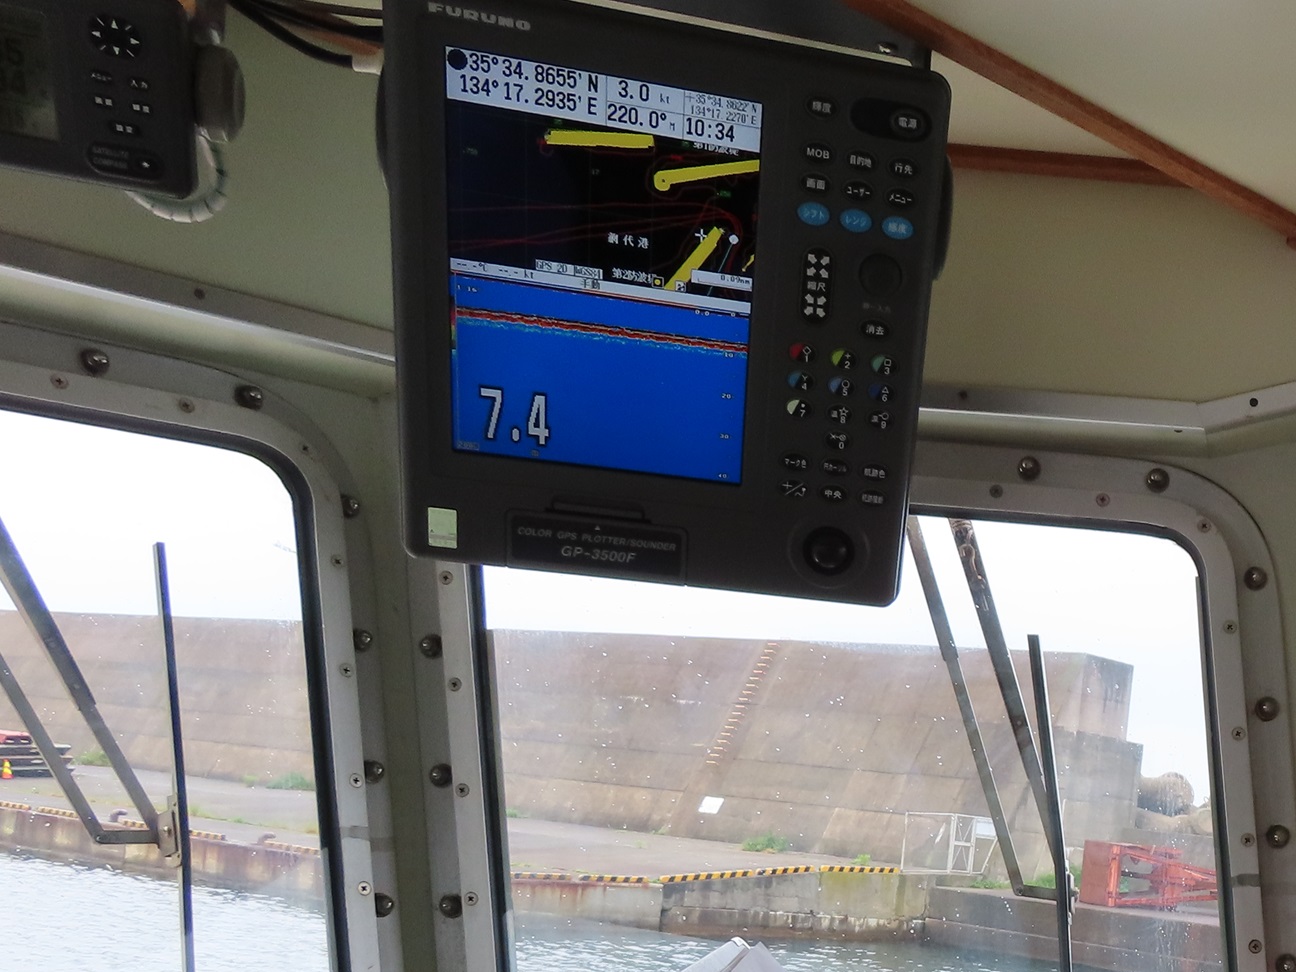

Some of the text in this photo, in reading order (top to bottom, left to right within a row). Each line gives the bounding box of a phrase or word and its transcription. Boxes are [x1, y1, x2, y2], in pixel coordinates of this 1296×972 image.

[427, 2, 531, 31] FURUNO
[588, 73, 598, 93] N
[618, 80, 670, 104] 3.0 kt
[588, 97, 598, 115] E
[898, 117, 917, 129] 電源
[686, 117, 735, 143] 10:34
[807, 147, 830, 159] MOB
[850, 155, 872, 168] 目的地
[895, 163, 913, 175] 行先
[806, 178, 826, 190] 画面
[847, 186, 870, 196] ユーザー
[889, 193, 912, 204] メニュー
[803, 209, 825, 220] シフト
[845, 215, 867, 227] レンジ
[536, 260, 552, 271] GPS
[807, 281, 826, 292] 縮尺
[866, 324, 885, 336] 消去
[845, 361, 850, 369] 2
[884, 367, 890, 375] 3
[842, 388, 848, 396] 5
[882, 394, 888, 402] 6
[479, 387, 550, 446] 7.4
[800, 409, 806, 418] 7
[840, 416, 846, 424] 8
[881, 421, 887, 429] 9
[785, 458, 806, 469] マーク色
[824, 489, 842, 499] 中央
[517, 526, 676, 551] COLOR GPS PLOTTER/SOUNDER
[561, 545, 637, 563] GP-3500F
